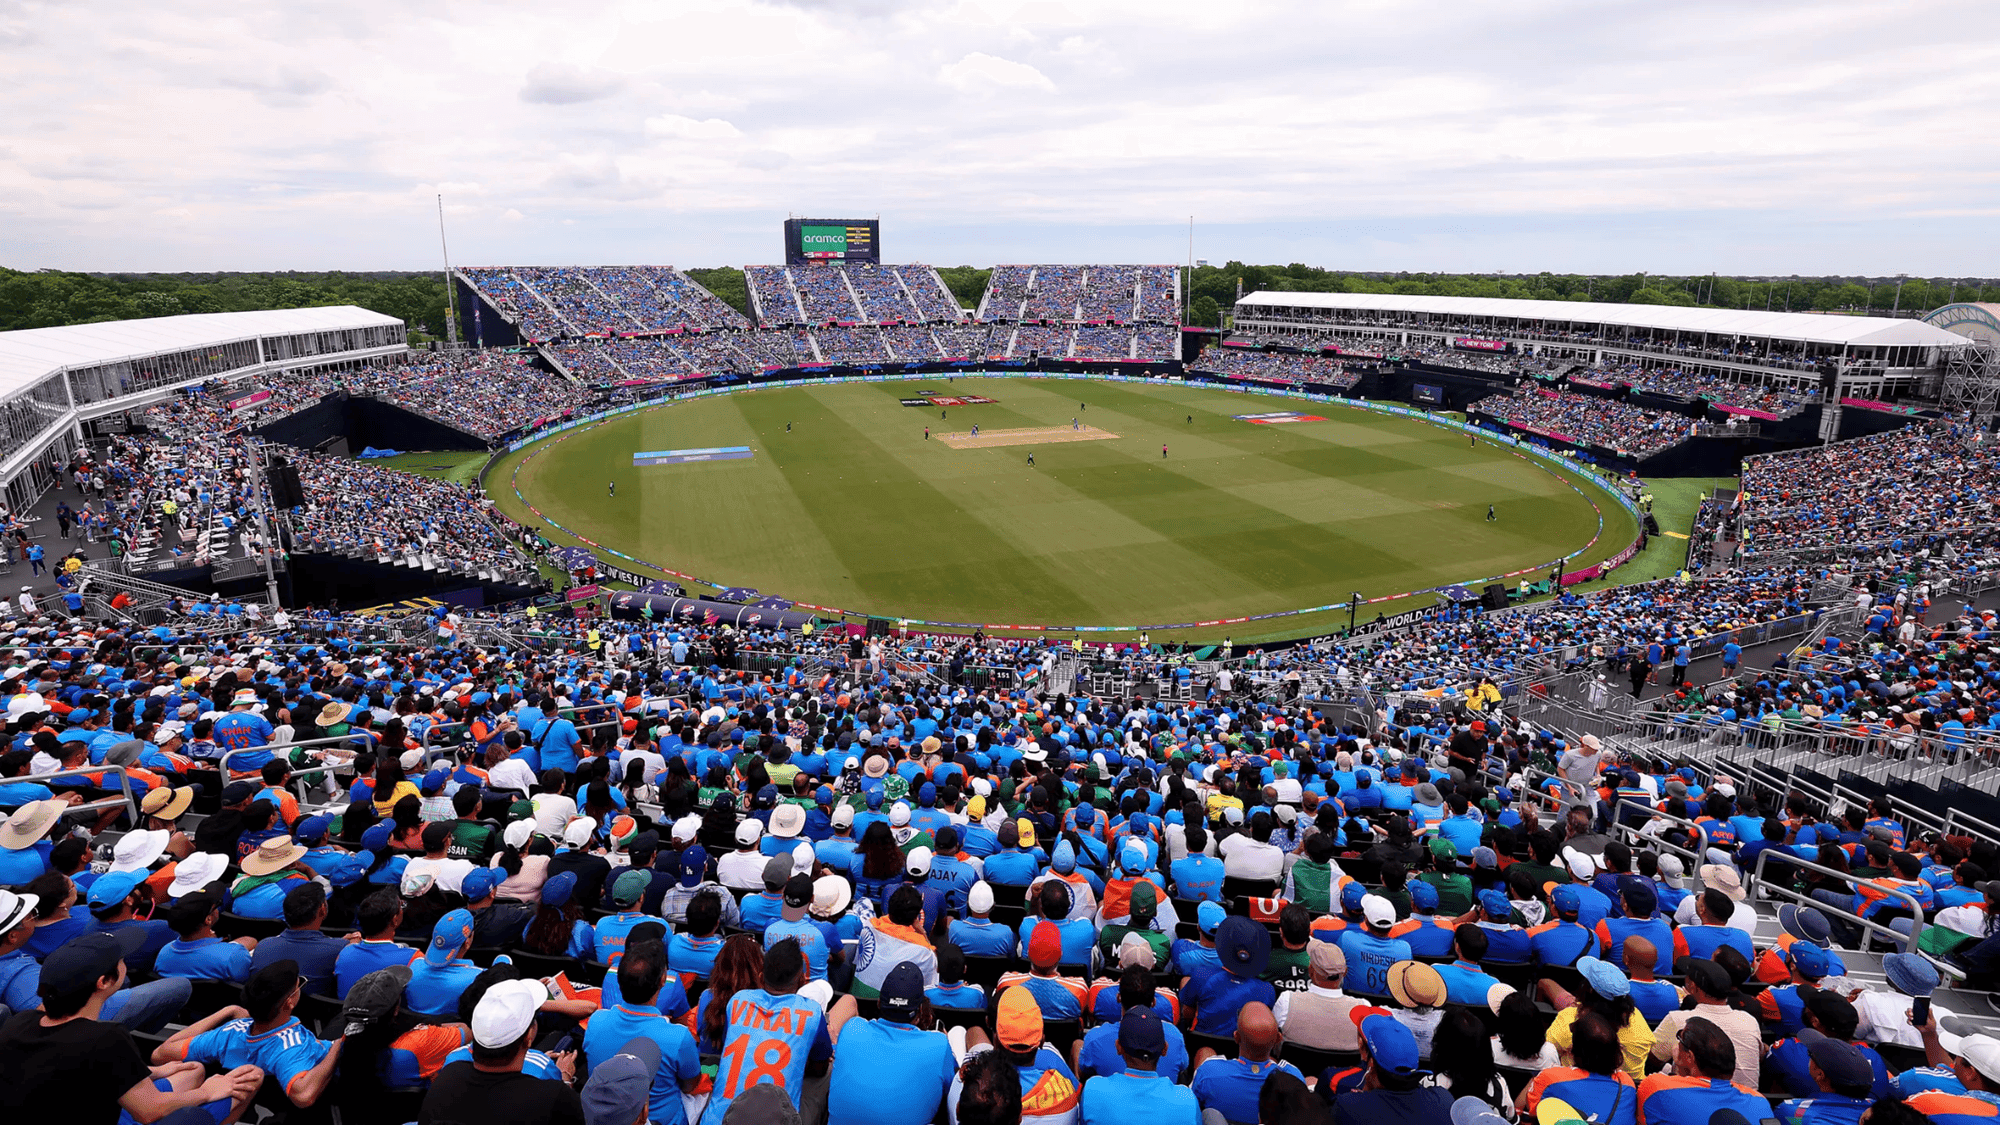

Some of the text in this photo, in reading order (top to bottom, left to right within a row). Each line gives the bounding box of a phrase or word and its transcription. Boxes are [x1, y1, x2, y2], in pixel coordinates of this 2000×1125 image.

[804, 235, 845, 243] aramco
[1387, 610, 1423, 630] WORLD
[929, 868, 958, 883] AJAY
[1361, 950, 1398, 967] NIRDESH
[729, 998, 814, 1037] VIRAT
[722, 1033, 793, 1100] 18
